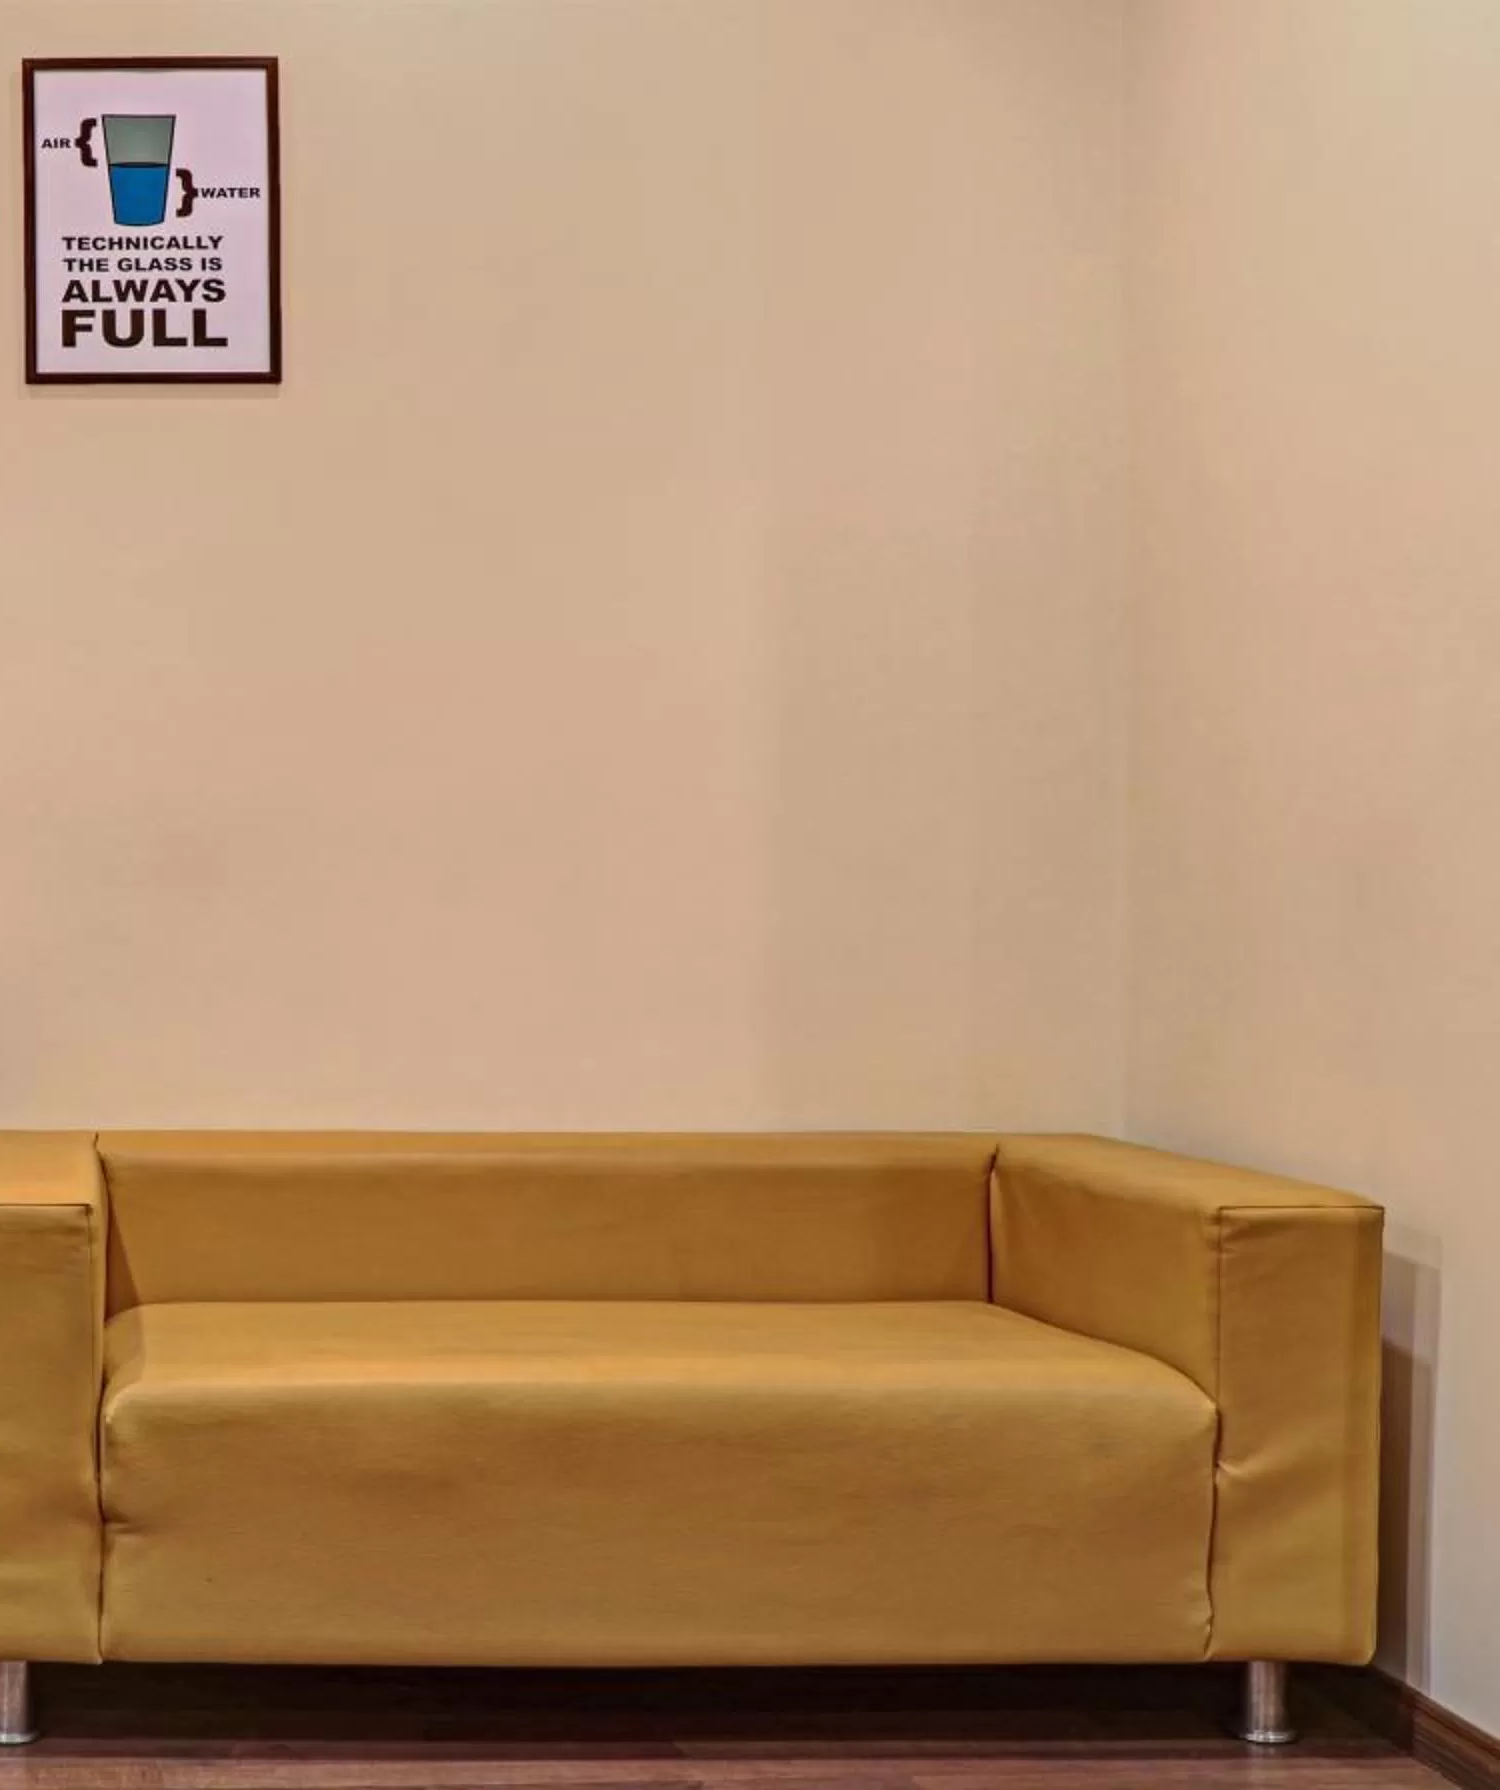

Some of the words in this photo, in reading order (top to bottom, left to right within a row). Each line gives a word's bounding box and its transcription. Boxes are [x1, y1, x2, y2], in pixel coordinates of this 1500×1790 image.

[41, 138, 71, 149] AIR
[200, 187, 261, 199] WATER
[61, 236, 224, 251] TECHNICALLY
[63, 258, 109, 272] THE
[117, 258, 193, 272] GLASS
[201, 257, 223, 271] IS
[61, 279, 226, 303] ALWAYS
[61, 308, 228, 348] FULL
